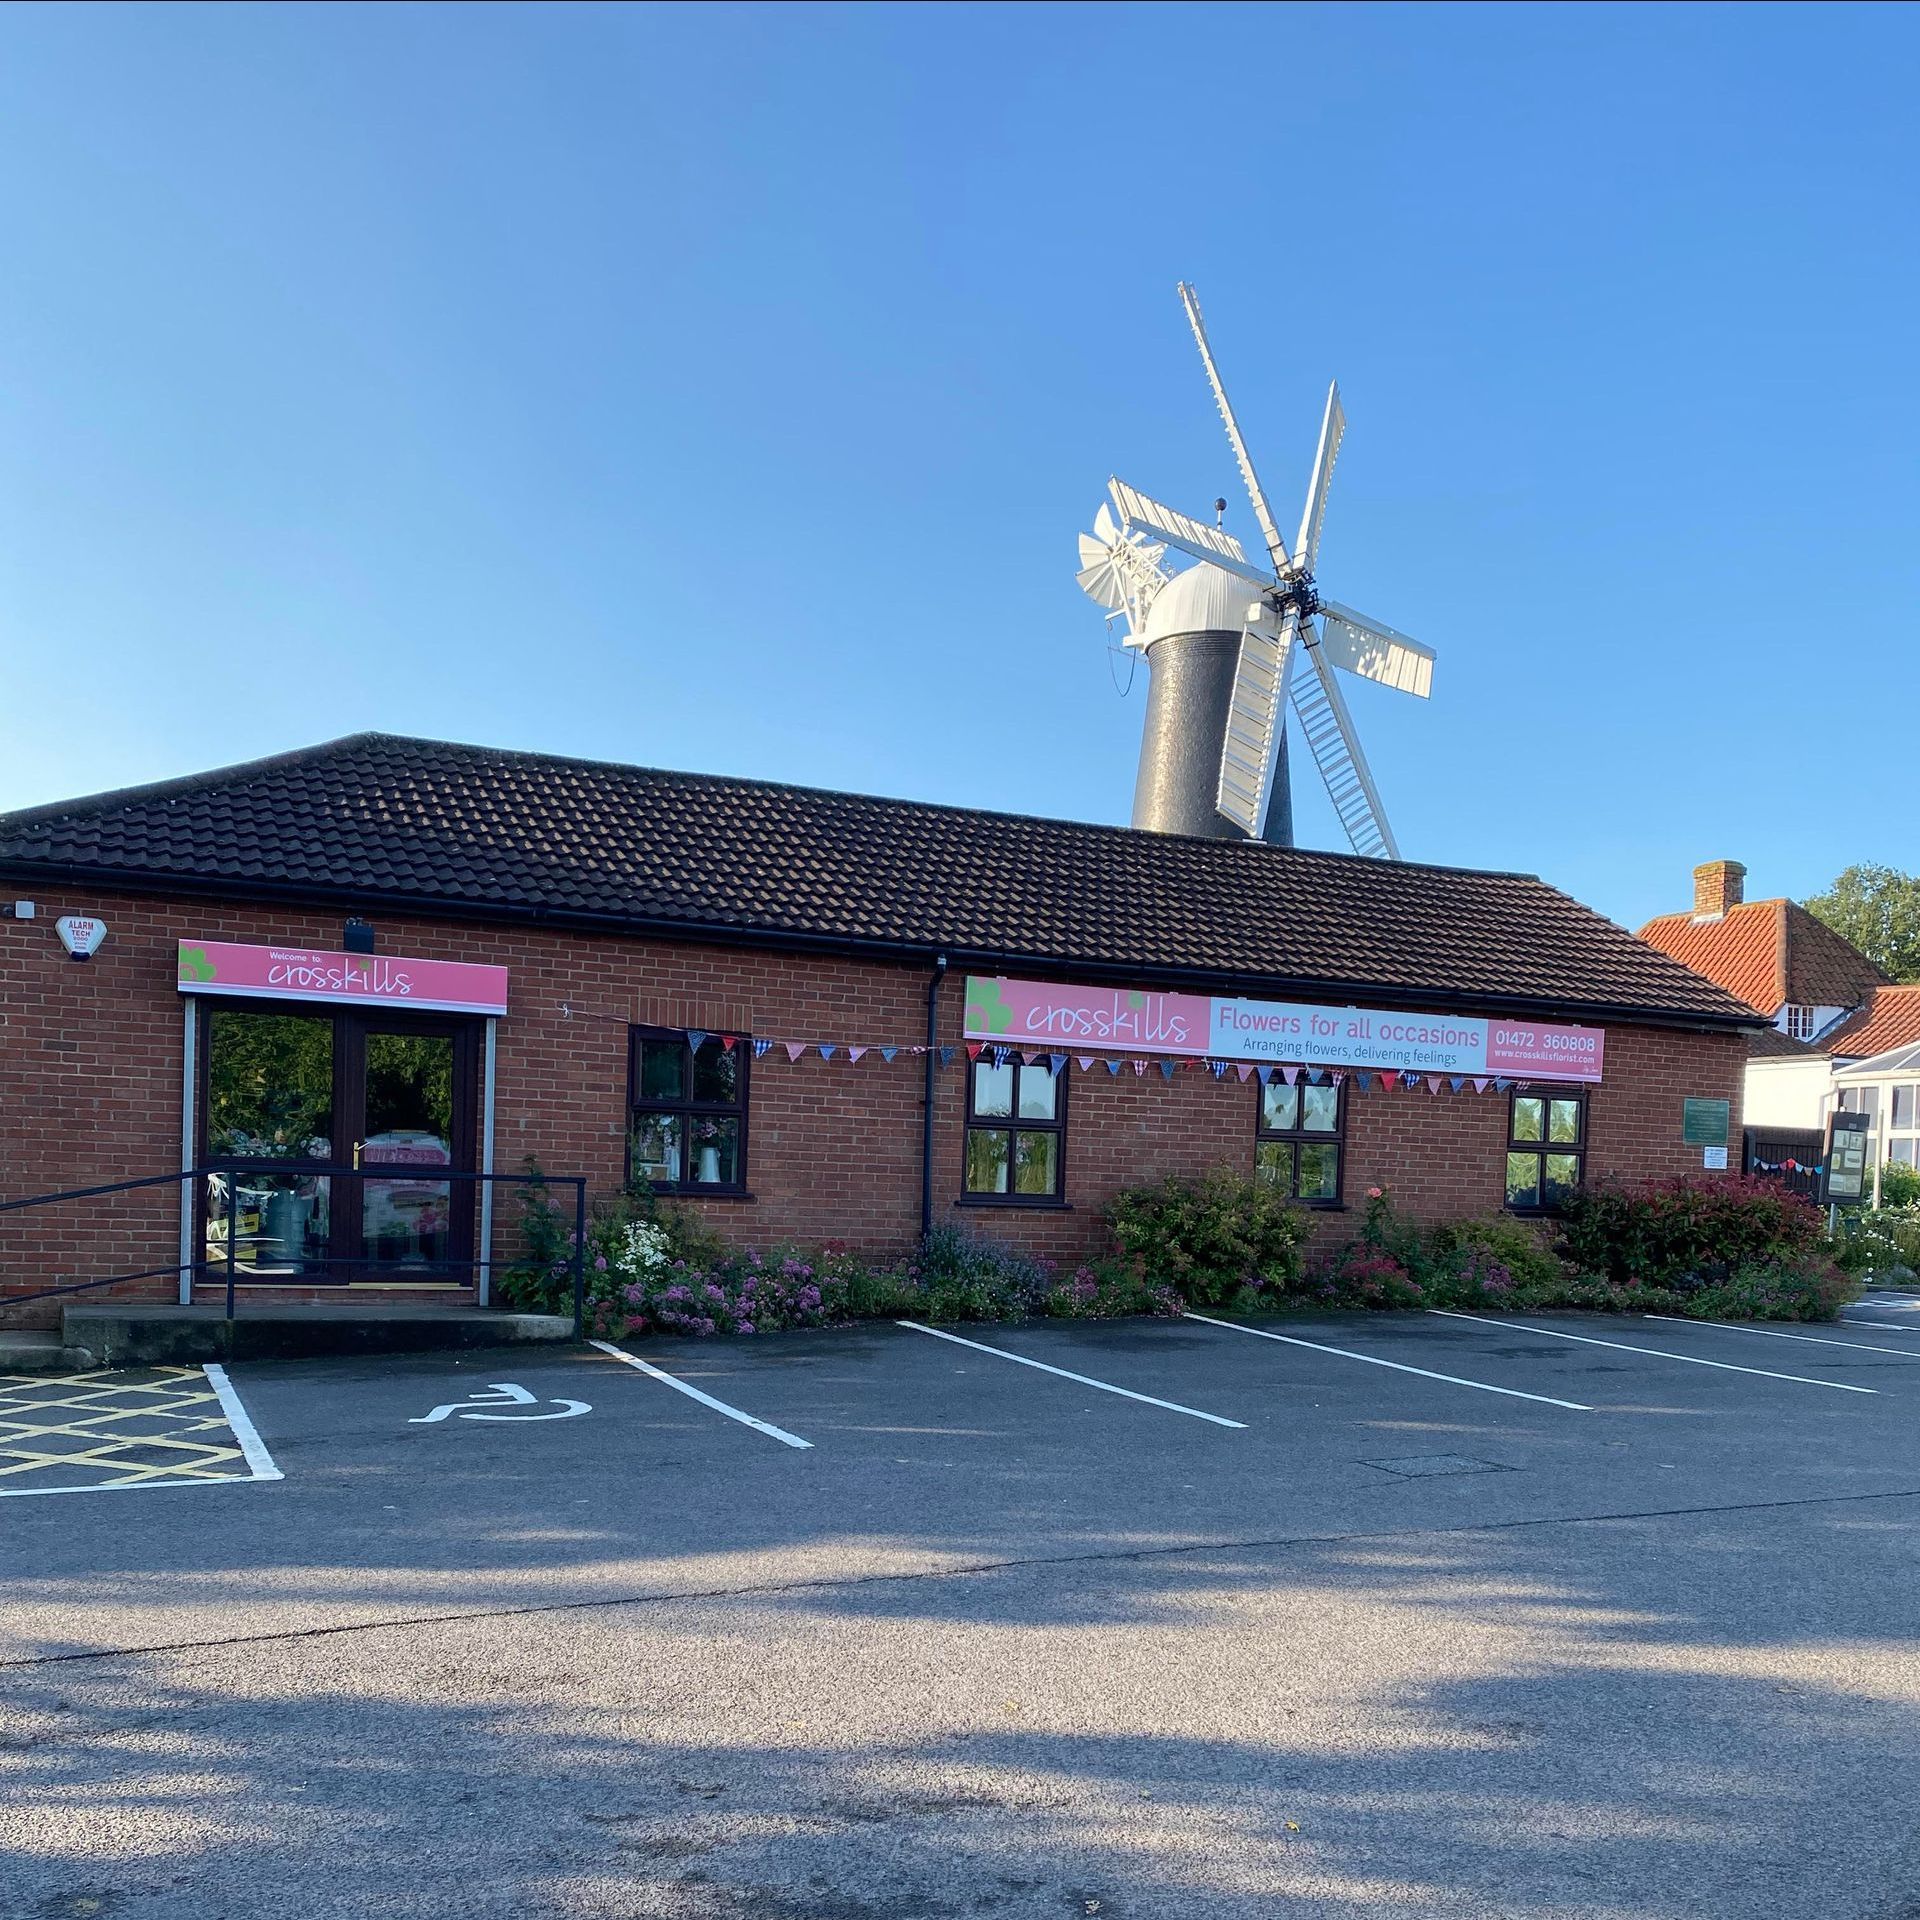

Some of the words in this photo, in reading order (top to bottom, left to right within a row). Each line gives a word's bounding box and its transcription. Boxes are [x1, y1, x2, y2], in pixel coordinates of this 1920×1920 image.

[68, 919, 94, 931] ALARM
[71, 929, 91, 937] TECH
[269, 951, 307, 962] Welcome
[268, 957, 414, 995] crosskills
[1026, 991, 1191, 1043] crosskills
[1219, 1006, 1301, 1034] Flowers
[1310, 1013, 1340, 1037] for
[1346, 1018, 1371, 1040] all
[1380, 1023, 1480, 1048] occasions
[1243, 1038, 1303, 1057] Arranging
[1304, 1041, 1353, 1060] flowers,
[1354, 1045, 1411, 1065] delivering
[1412, 1048, 1457, 1068] feelings
[1495, 1030, 1535, 1048] 01472
[1543, 1034, 1596, 1053] 360808
[1494, 1049, 1596, 1065] www.crosskillsflorist.com
